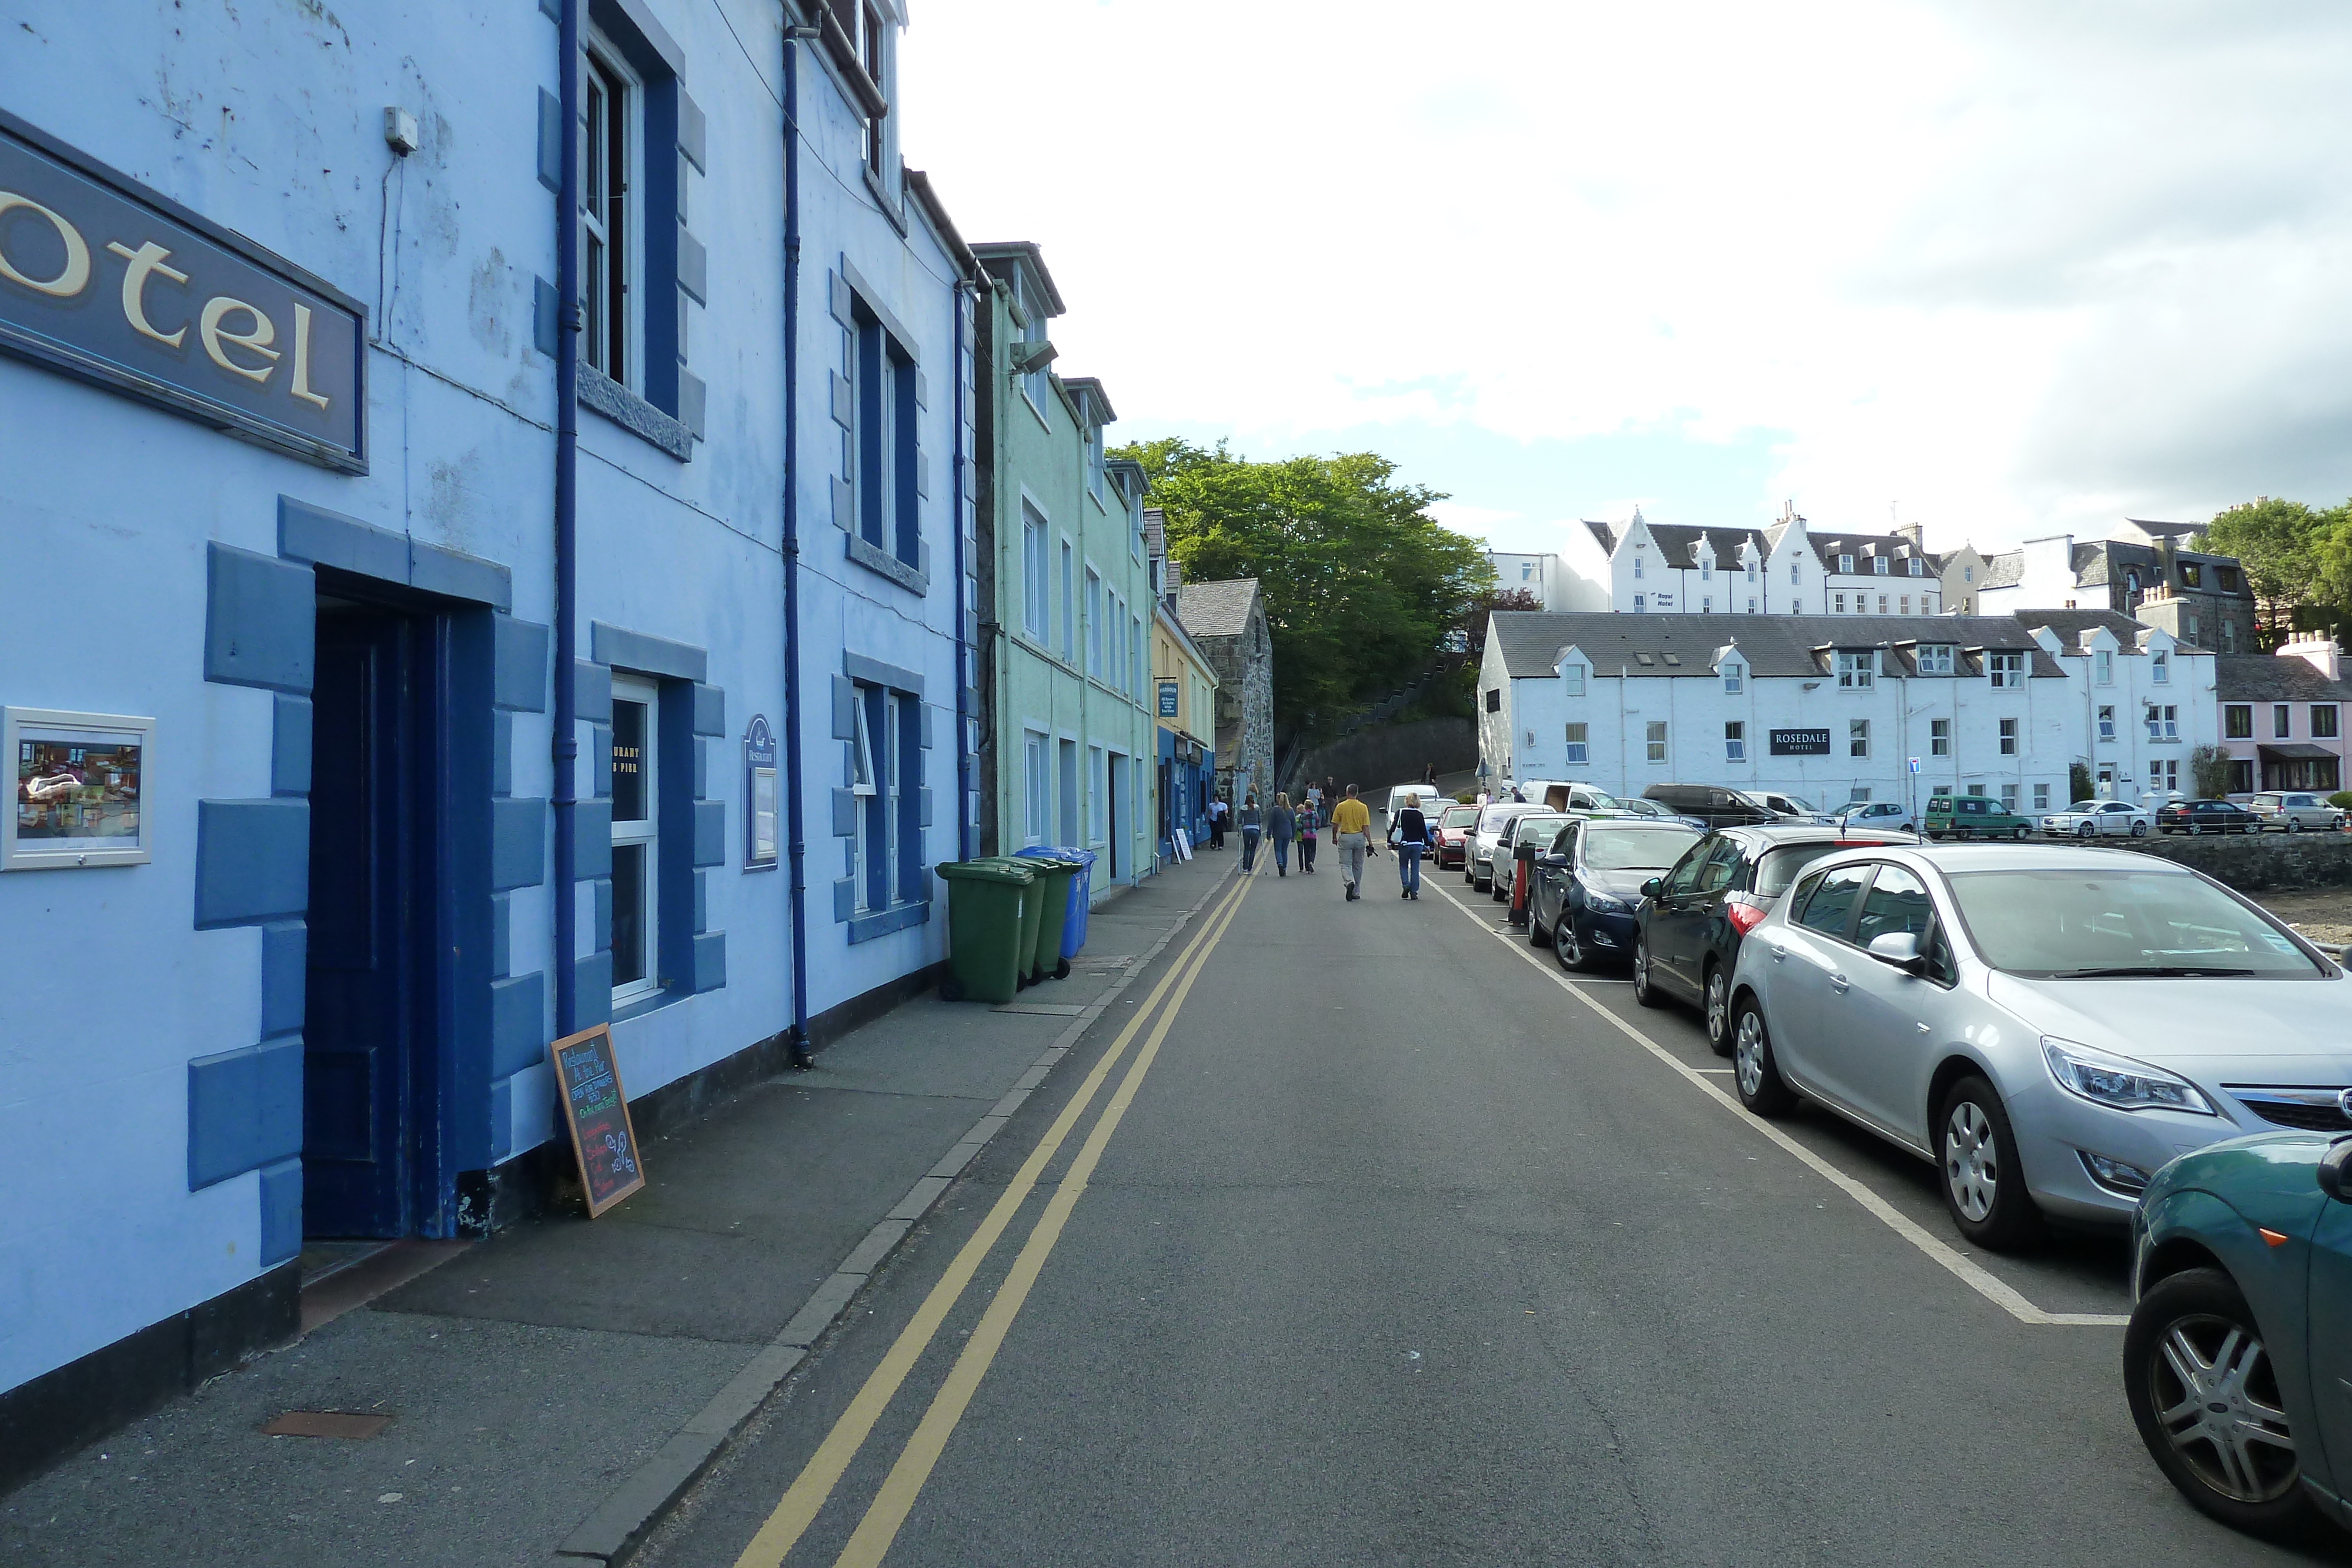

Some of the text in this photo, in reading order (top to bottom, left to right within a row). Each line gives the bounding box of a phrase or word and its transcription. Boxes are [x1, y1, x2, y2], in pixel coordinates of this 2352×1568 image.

[1776, 734, 1827, 743] ROSEDALE
[749, 750, 772, 762] Restaurant
[620, 763, 637, 773] PIER
[562, 1041, 599, 1069] Restaurant
[571, 1087, 584, 1101] OPEN
